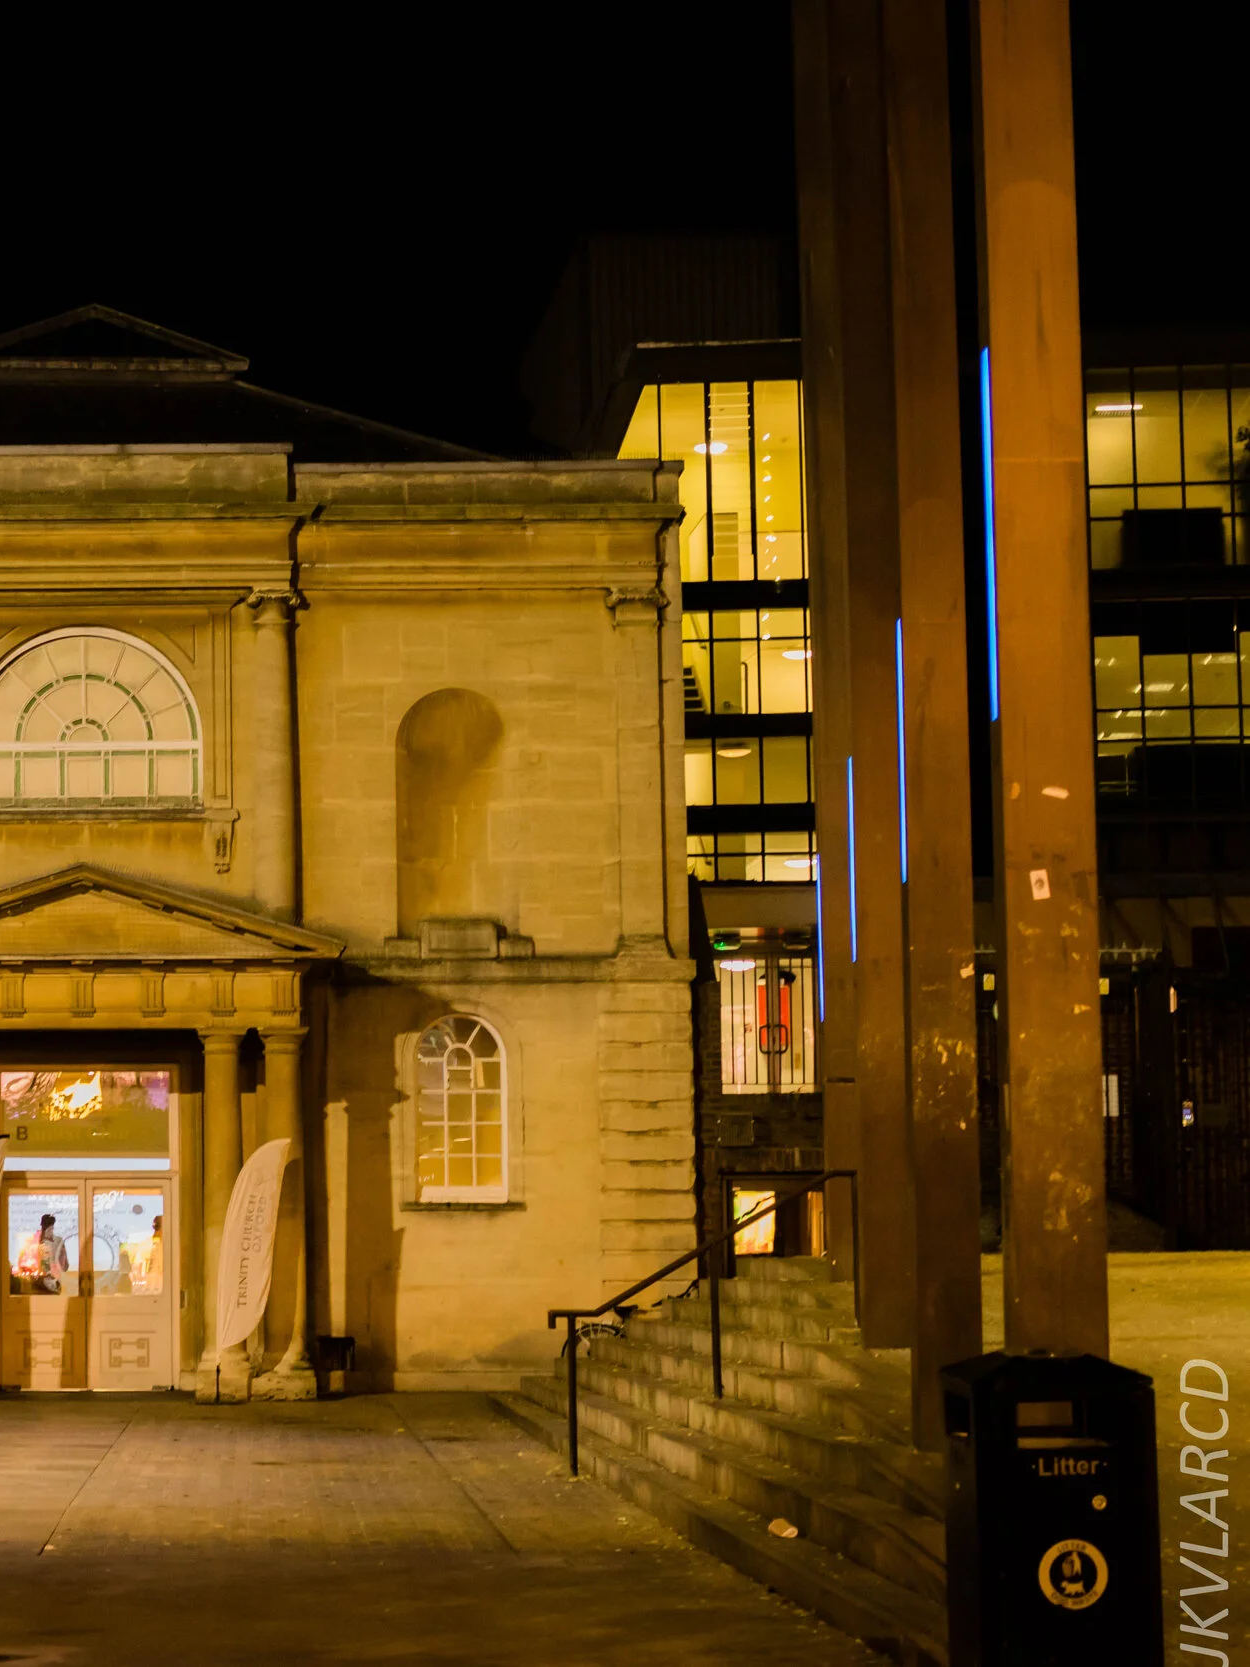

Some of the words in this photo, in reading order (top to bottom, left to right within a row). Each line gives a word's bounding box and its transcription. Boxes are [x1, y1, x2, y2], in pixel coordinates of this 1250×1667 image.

[240, 1194, 257, 1252] CHURCH
[252, 1196, 267, 1253] OXFORD
[236, 1256, 250, 1309] TRINITY
[1038, 1457, 1100, 1477] Litter
